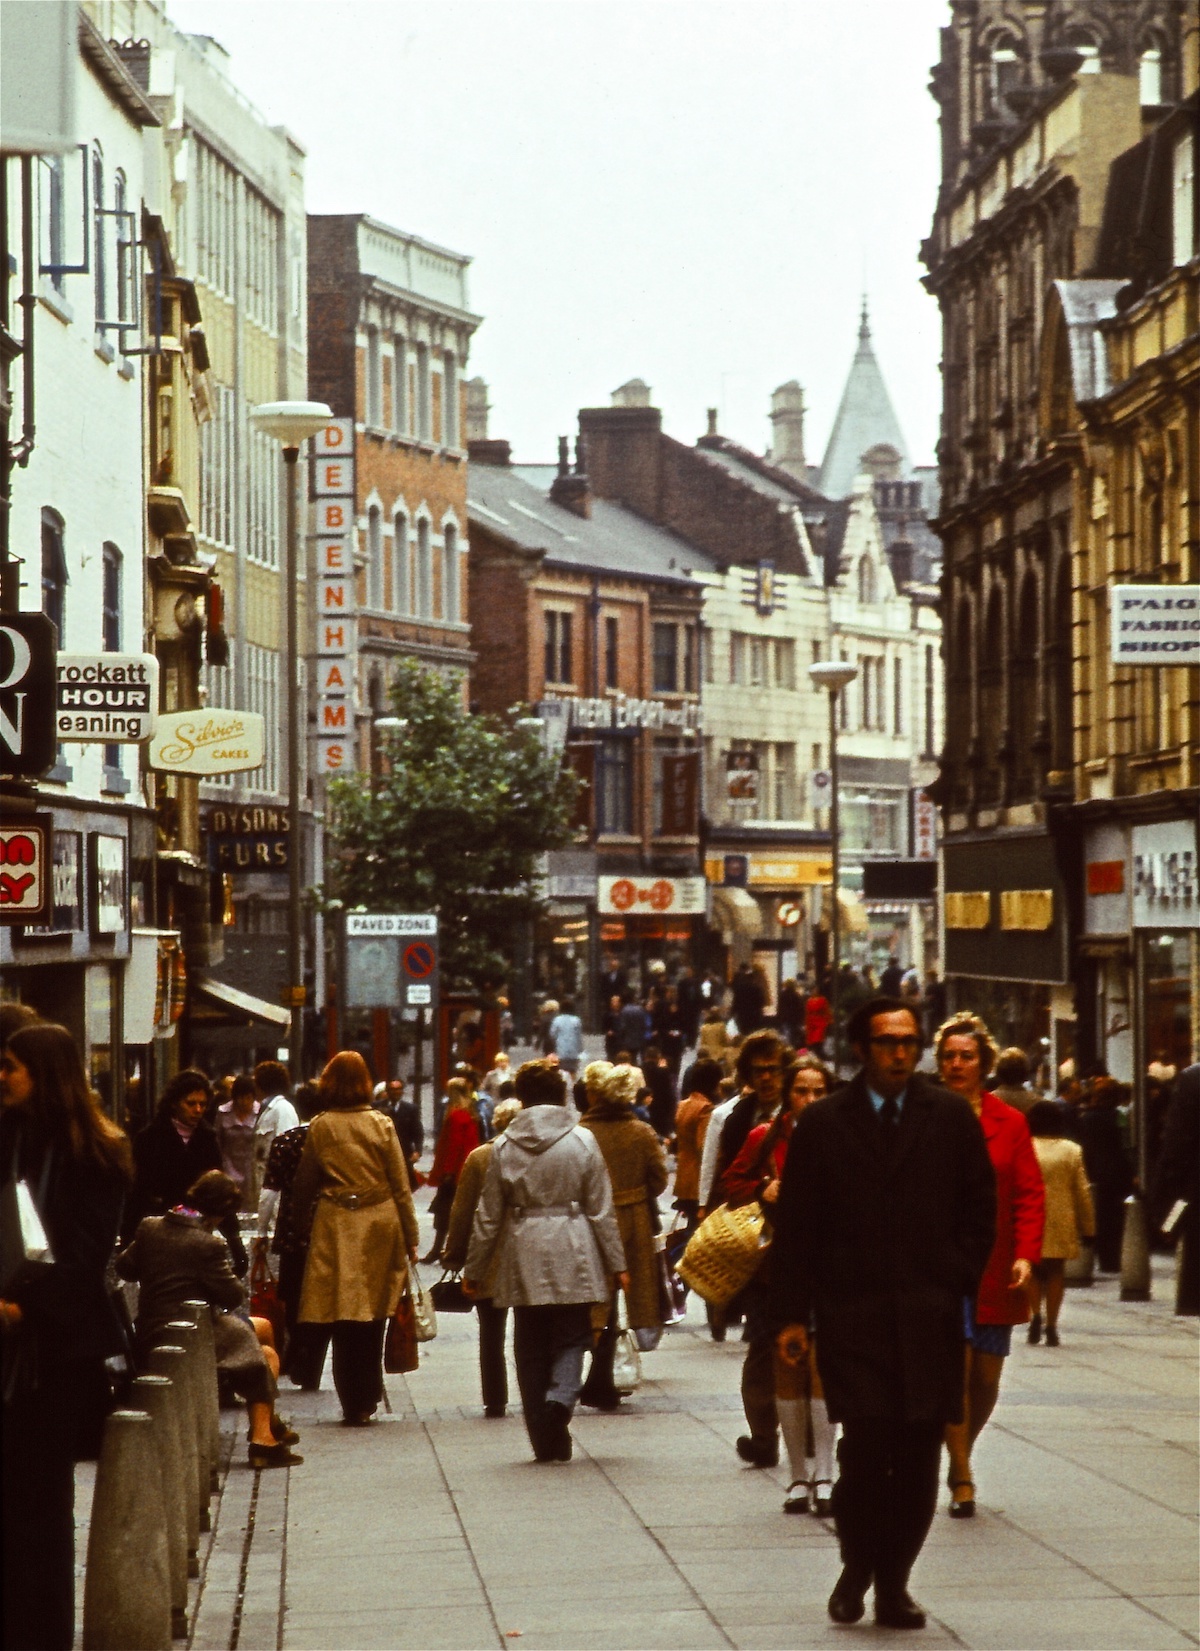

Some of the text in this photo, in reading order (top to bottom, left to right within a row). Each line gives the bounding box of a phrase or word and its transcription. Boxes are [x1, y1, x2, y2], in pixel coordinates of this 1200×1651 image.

[324, 425, 346, 768] DEBENHAMS
[1120, 641, 1200, 652] SHOP
[62, 688, 147, 707] HOUR
[212, 749, 250, 760] CAKES
[353, 919, 431, 930] PAVED ZONE
